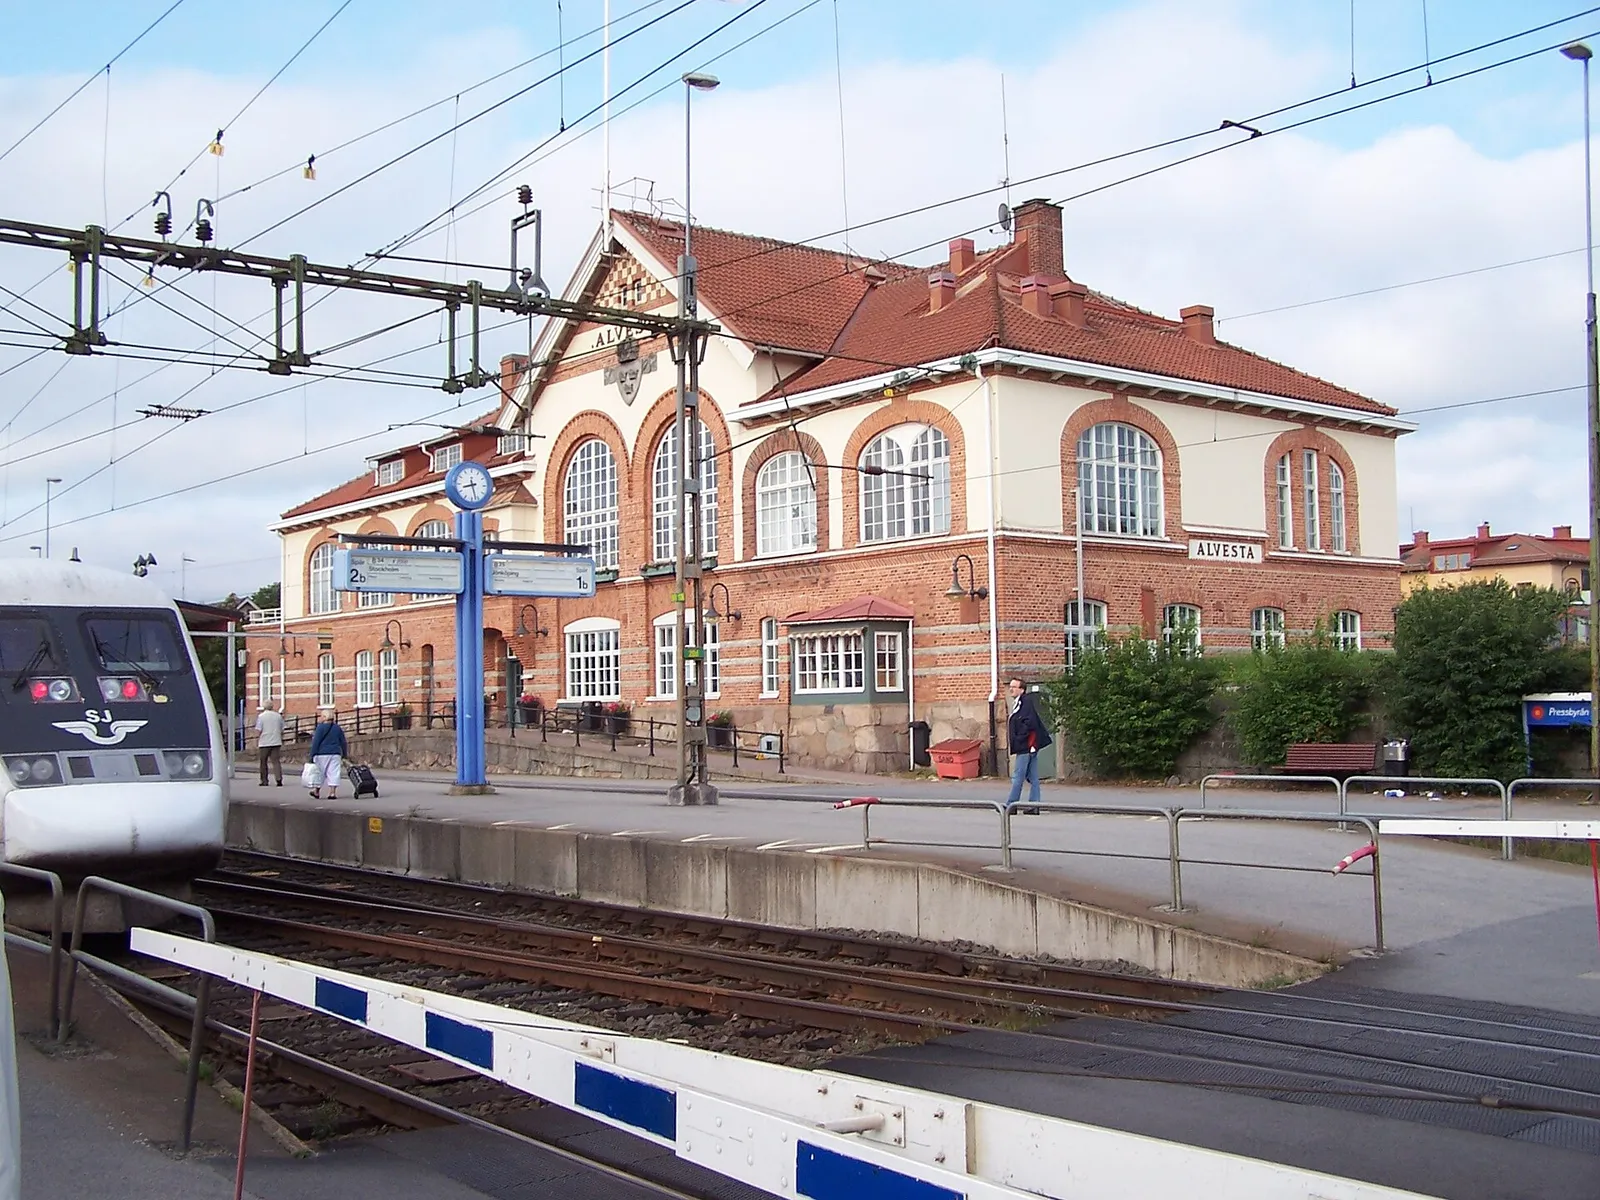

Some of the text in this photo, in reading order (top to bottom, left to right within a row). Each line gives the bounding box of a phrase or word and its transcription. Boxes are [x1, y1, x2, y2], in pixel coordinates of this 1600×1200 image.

[1196, 542, 1255, 559] ALVESTA
[350, 568, 366, 583] 2b
[576, 576, 589, 590] 1b
[85, 709, 113, 723] SJ
[1548, 707, 1590, 718] Pressbyrån
